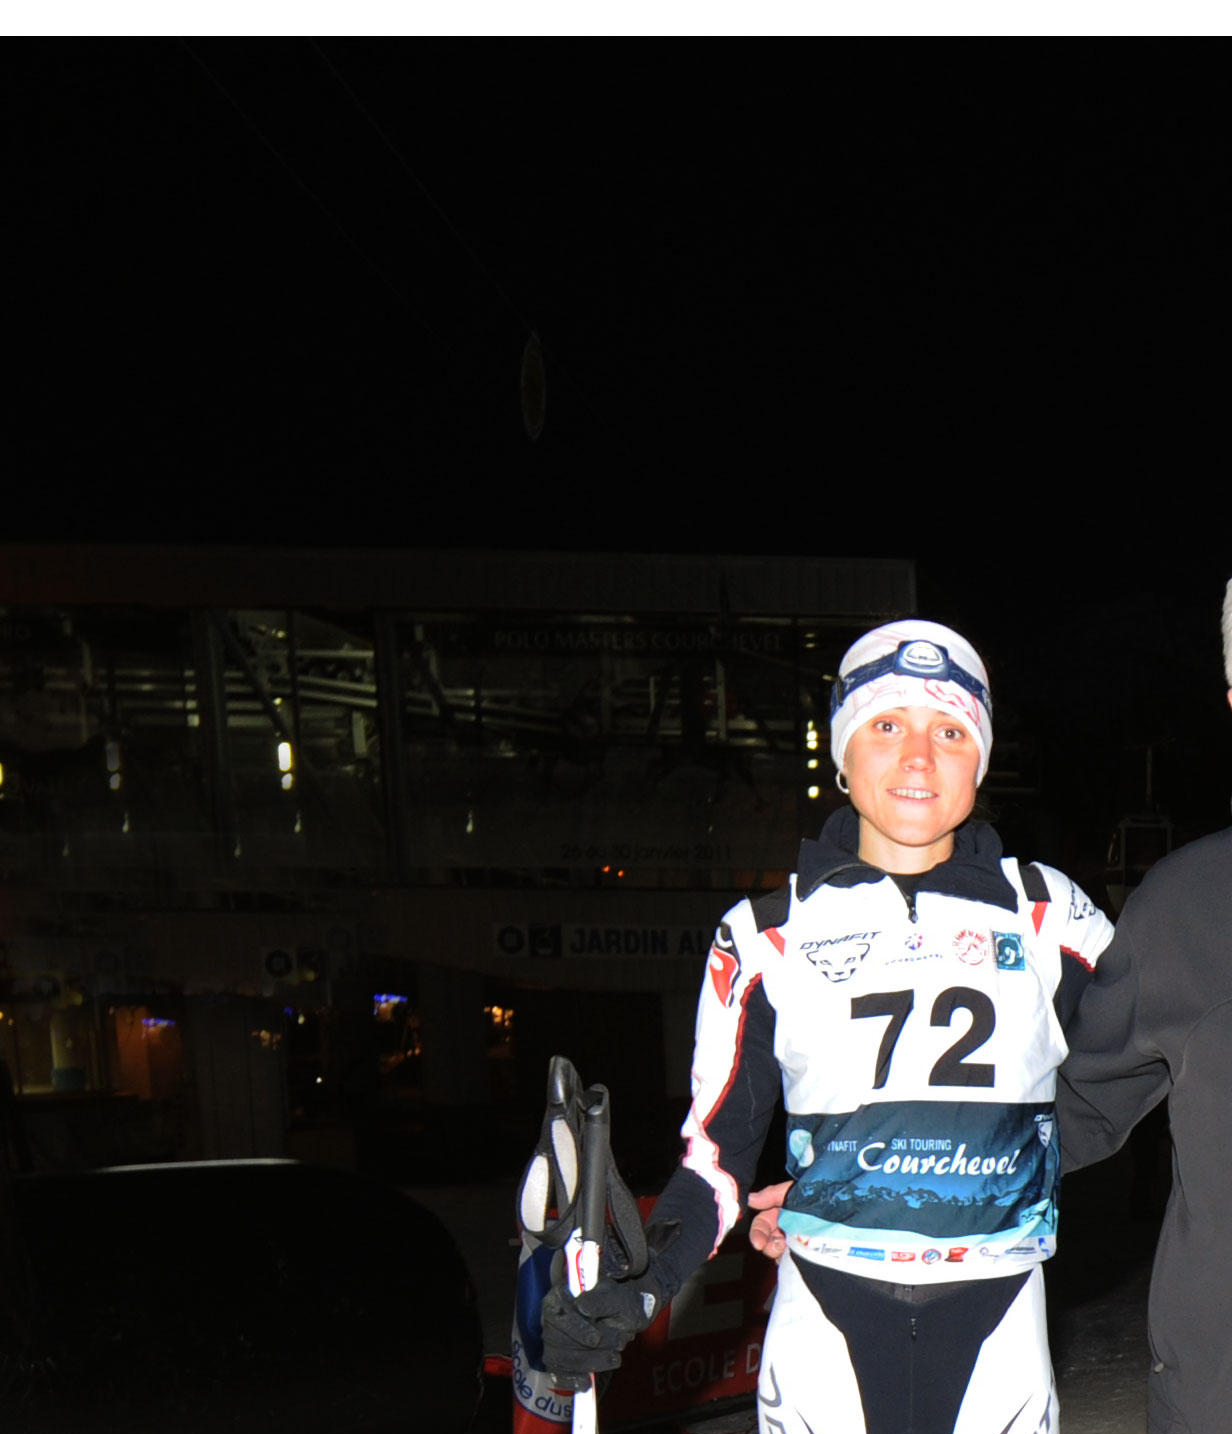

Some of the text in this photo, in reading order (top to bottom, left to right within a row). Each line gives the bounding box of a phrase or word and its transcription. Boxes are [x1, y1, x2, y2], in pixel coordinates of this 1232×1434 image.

[494, 631, 549, 650] POLO
[552, 631, 648, 650] MASTERS
[571, 928, 667, 955] JARDIN
[800, 931, 881, 950] DYNAFIT
[850, 986, 996, 1089] 72
[857, 1142, 1021, 1175] Courchevel
[891, 1139, 952, 1151] SKI TOURING
[653, 1349, 737, 1397] ECOLE
